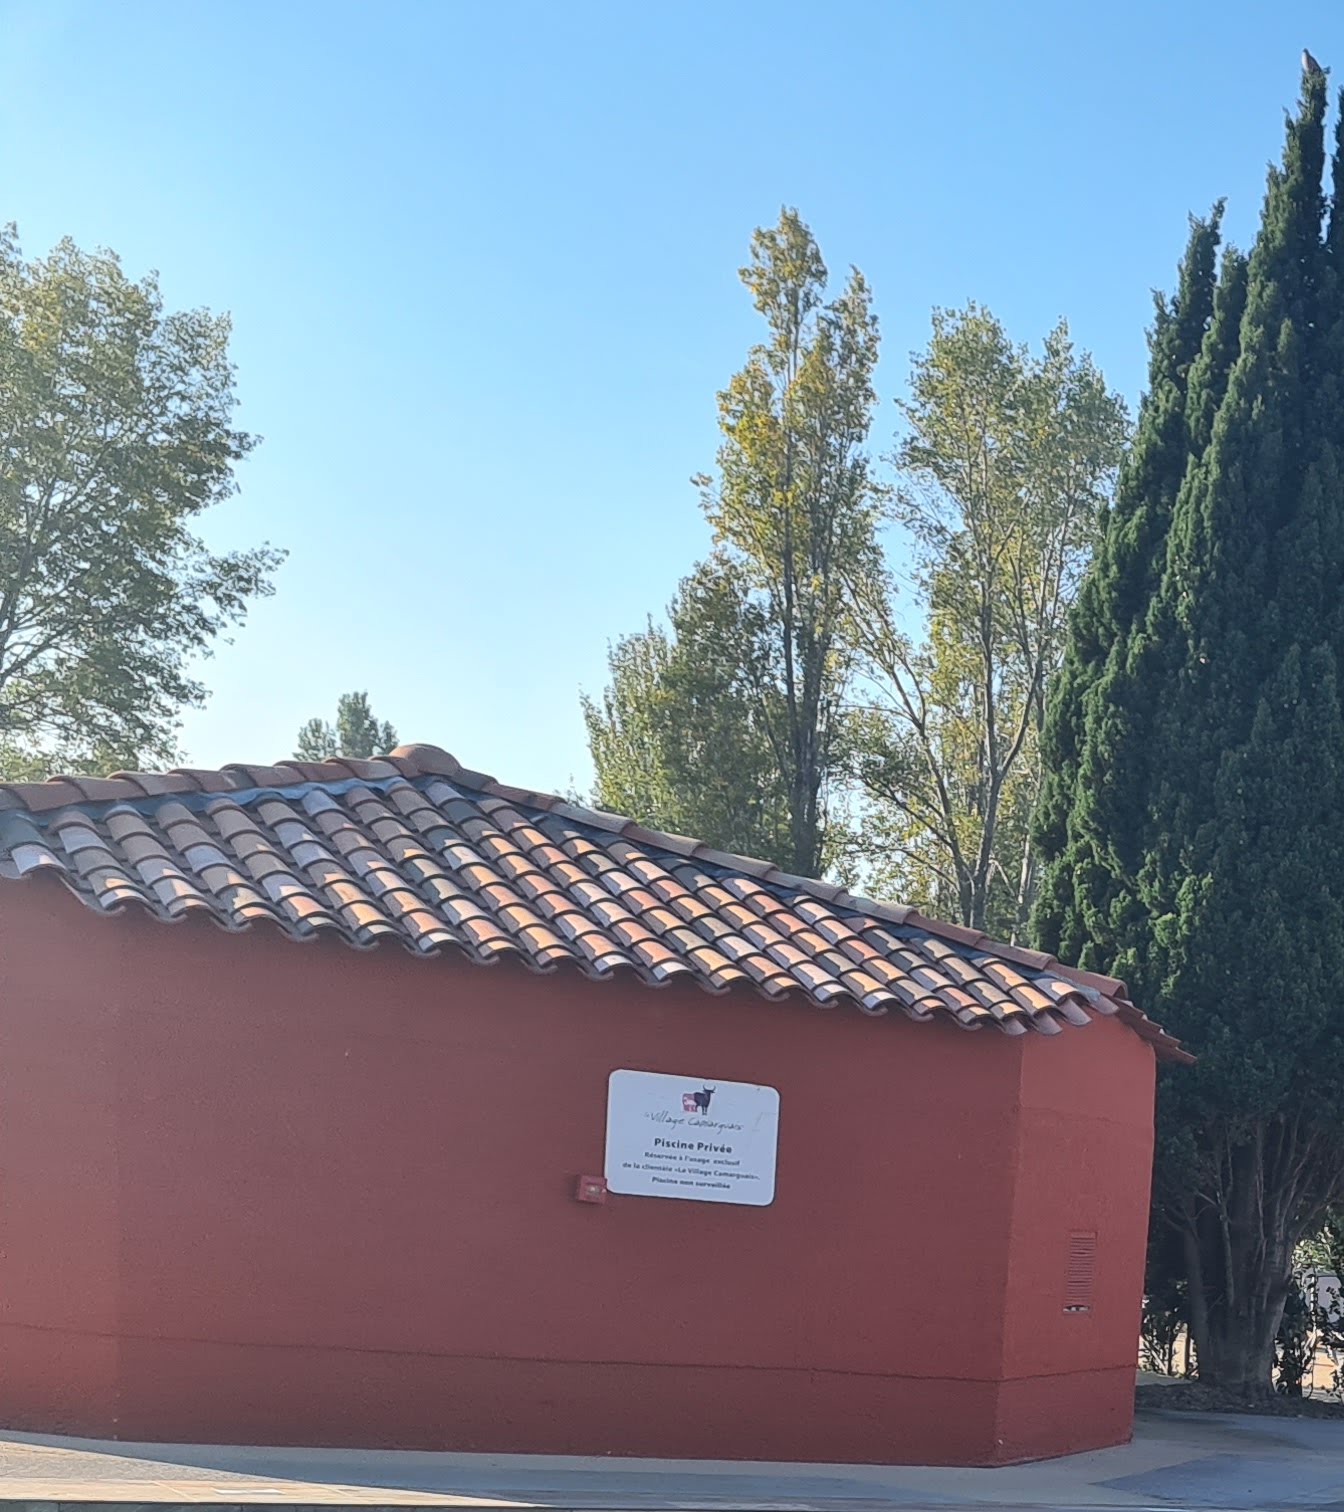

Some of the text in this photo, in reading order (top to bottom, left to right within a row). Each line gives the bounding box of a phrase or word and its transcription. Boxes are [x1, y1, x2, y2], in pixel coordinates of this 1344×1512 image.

[654, 1138, 733, 1154] Piscine Privée
[688, 1168, 712, 1176] Village
